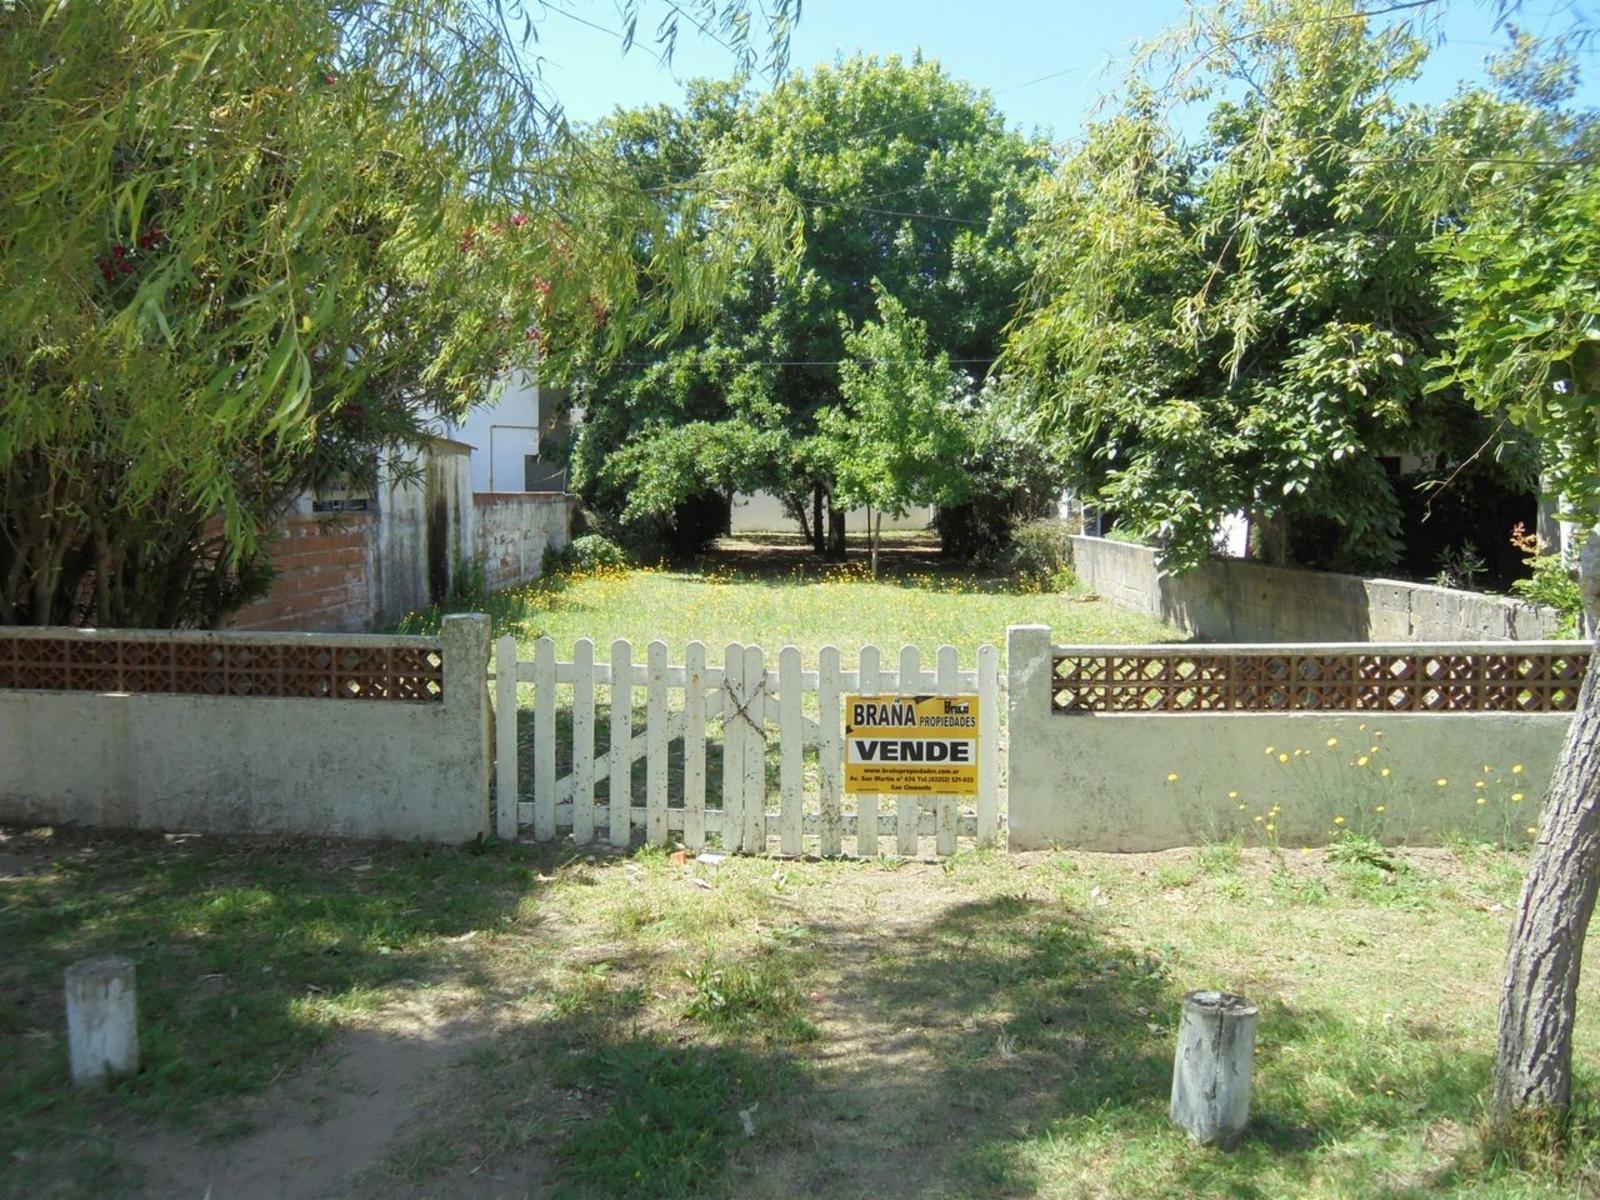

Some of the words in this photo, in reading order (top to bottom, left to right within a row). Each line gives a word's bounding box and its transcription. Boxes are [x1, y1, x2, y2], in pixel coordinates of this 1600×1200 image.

[853, 697, 916, 726] BRAÑA
[919, 715, 976, 727] PROPIEDADES
[855, 740, 969, 762] VENDE
